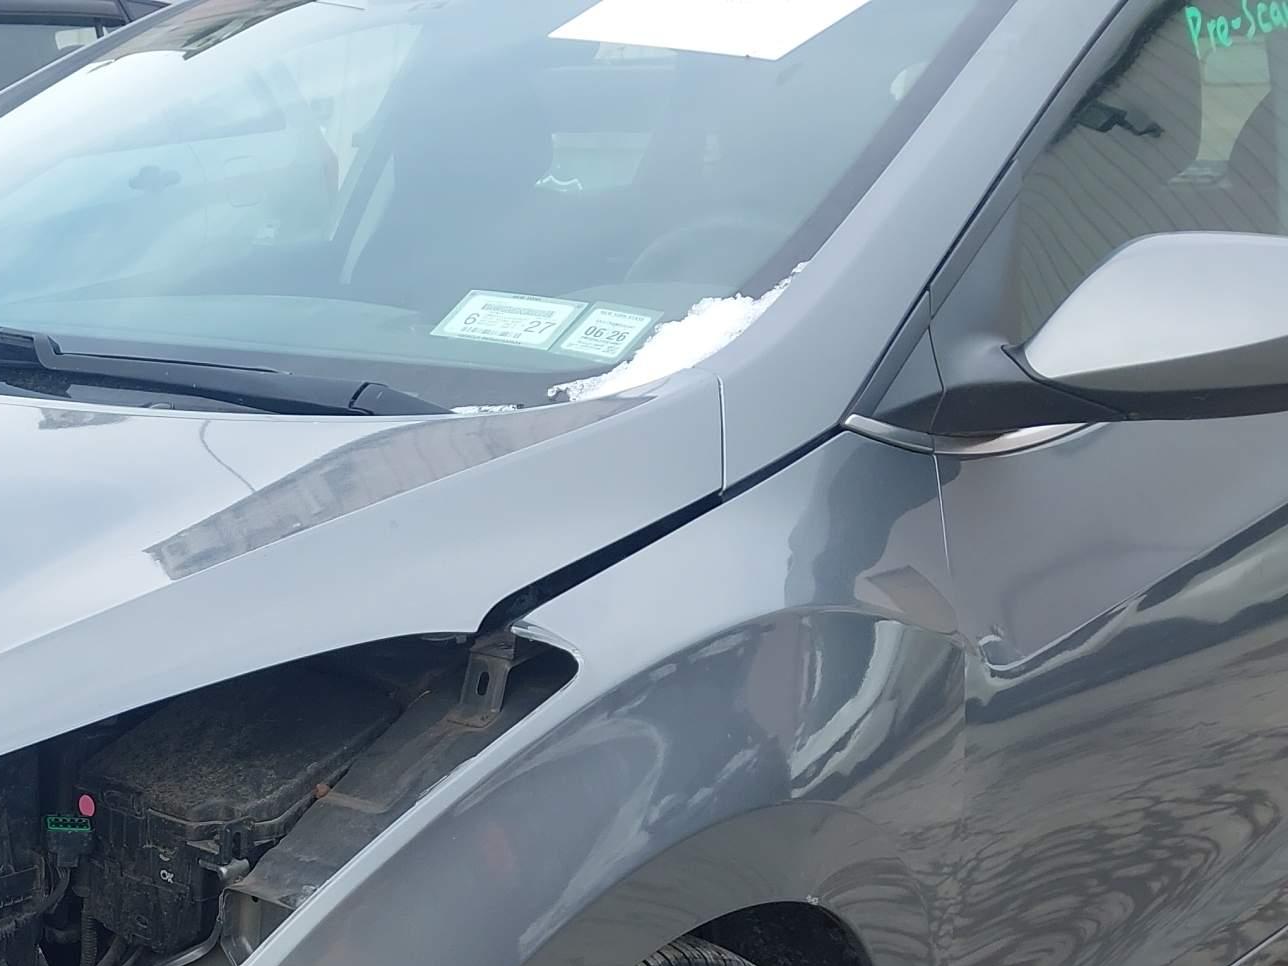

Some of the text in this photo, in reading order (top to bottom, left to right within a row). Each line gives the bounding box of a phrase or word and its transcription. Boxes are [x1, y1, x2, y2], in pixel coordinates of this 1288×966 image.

[464, 312, 480, 325] 6
[523, 320, 557, 334] 27
[584, 325, 630, 342] 06 26
